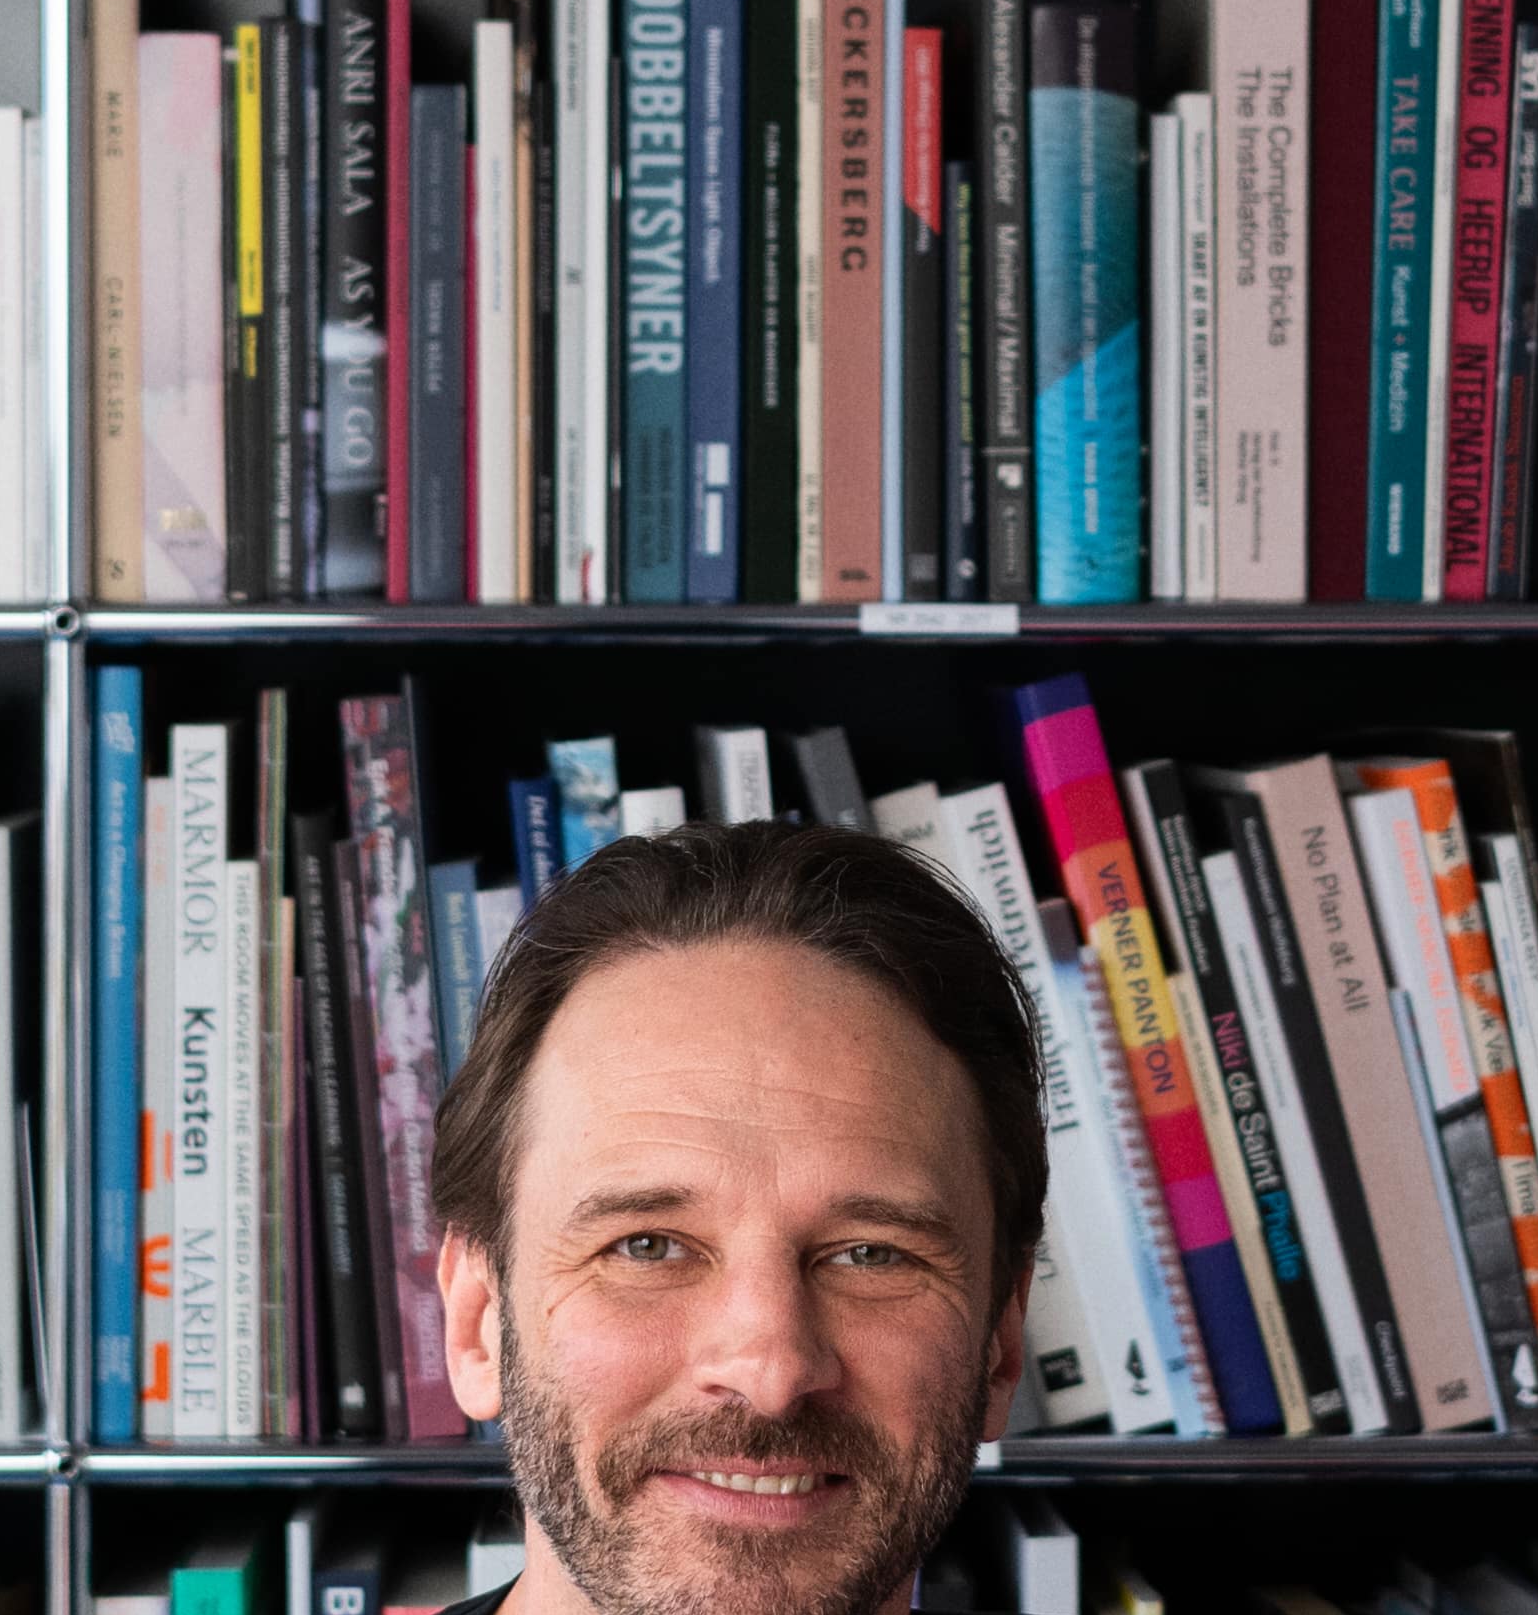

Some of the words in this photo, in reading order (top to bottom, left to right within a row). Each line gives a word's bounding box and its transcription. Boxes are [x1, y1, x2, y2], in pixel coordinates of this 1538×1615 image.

[342, 10, 373, 103] ANRI
[1238, 67, 1262, 118] The
[1269, 67, 1292, 118] The
[1389, 75, 1419, 155] TAKE
[343, 121, 374, 214] SALA
[1237, 125, 1262, 286] Installations
[1262, 125, 1292, 259] Complete
[1389, 167, 1418, 251] CARE
[1391, 266, 1412, 328] Kunst
[1456, 199, 1498, 315] HEERUP
[1269, 265, 1292, 347] Bricks
[1387, 352, 1411, 432] Medizin
[1446, 343, 1489, 573] INTERNATIONAL
[182, 747, 215, 956] MARMOR
[1300, 827, 1326, 867] No
[1307, 873, 1343, 933] Plan
[233, 923, 252, 985] ROOM
[1096, 862, 1138, 970] VERNER
[1121, 977, 1176, 1095] PANTON
[1326, 943, 1349, 969] at
[1338, 978, 1368, 1012] All
[1210, 1012, 1243, 1069] Niki
[181, 1008, 211, 1176] Kunsten
[1225, 1074, 1254, 1107] de
[1231, 1112, 1274, 1188] Saint
[1256, 1192, 1302, 1281] Phalle
[181, 1227, 214, 1413] MARBLE
